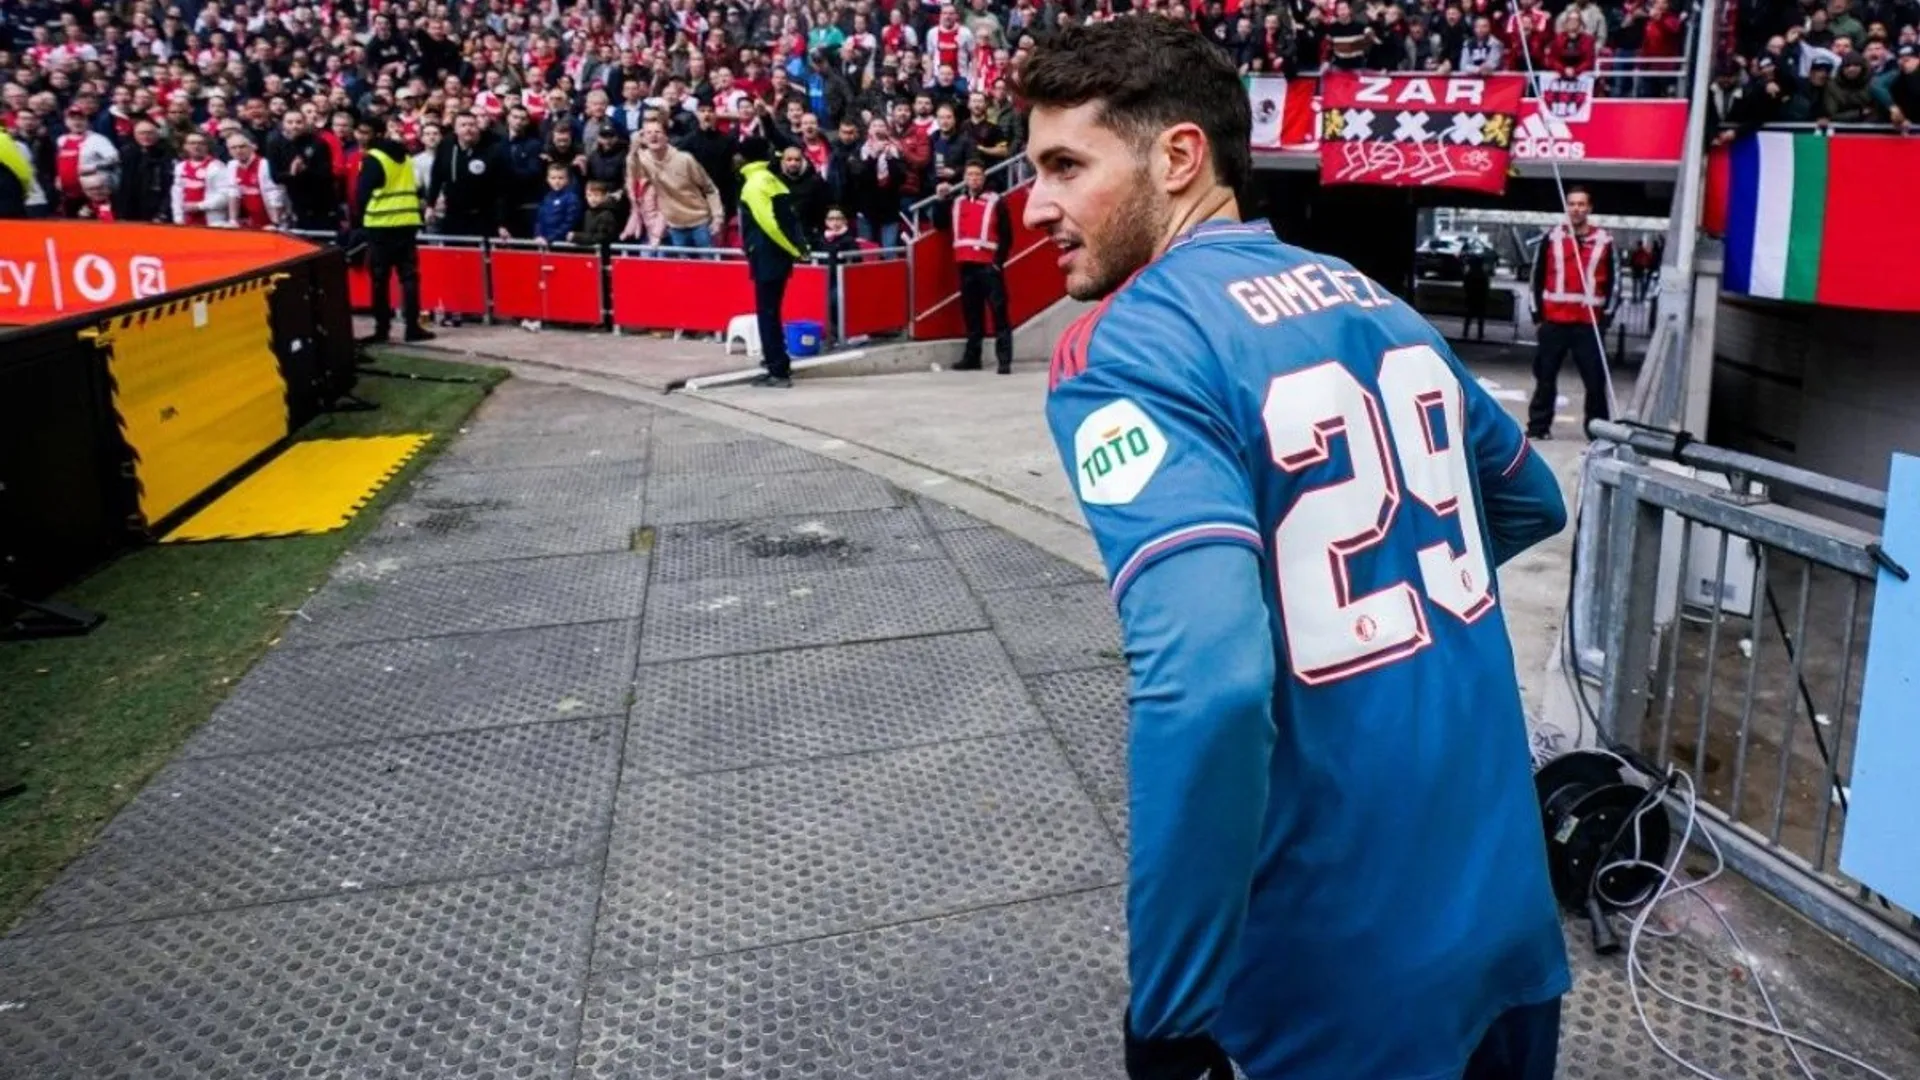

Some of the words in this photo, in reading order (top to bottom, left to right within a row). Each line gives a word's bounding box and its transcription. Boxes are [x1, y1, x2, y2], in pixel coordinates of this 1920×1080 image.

[1355, 76, 1486, 105] ZAR
[1081, 426, 1150, 488] TOTO
[1262, 344, 1496, 686] 29
